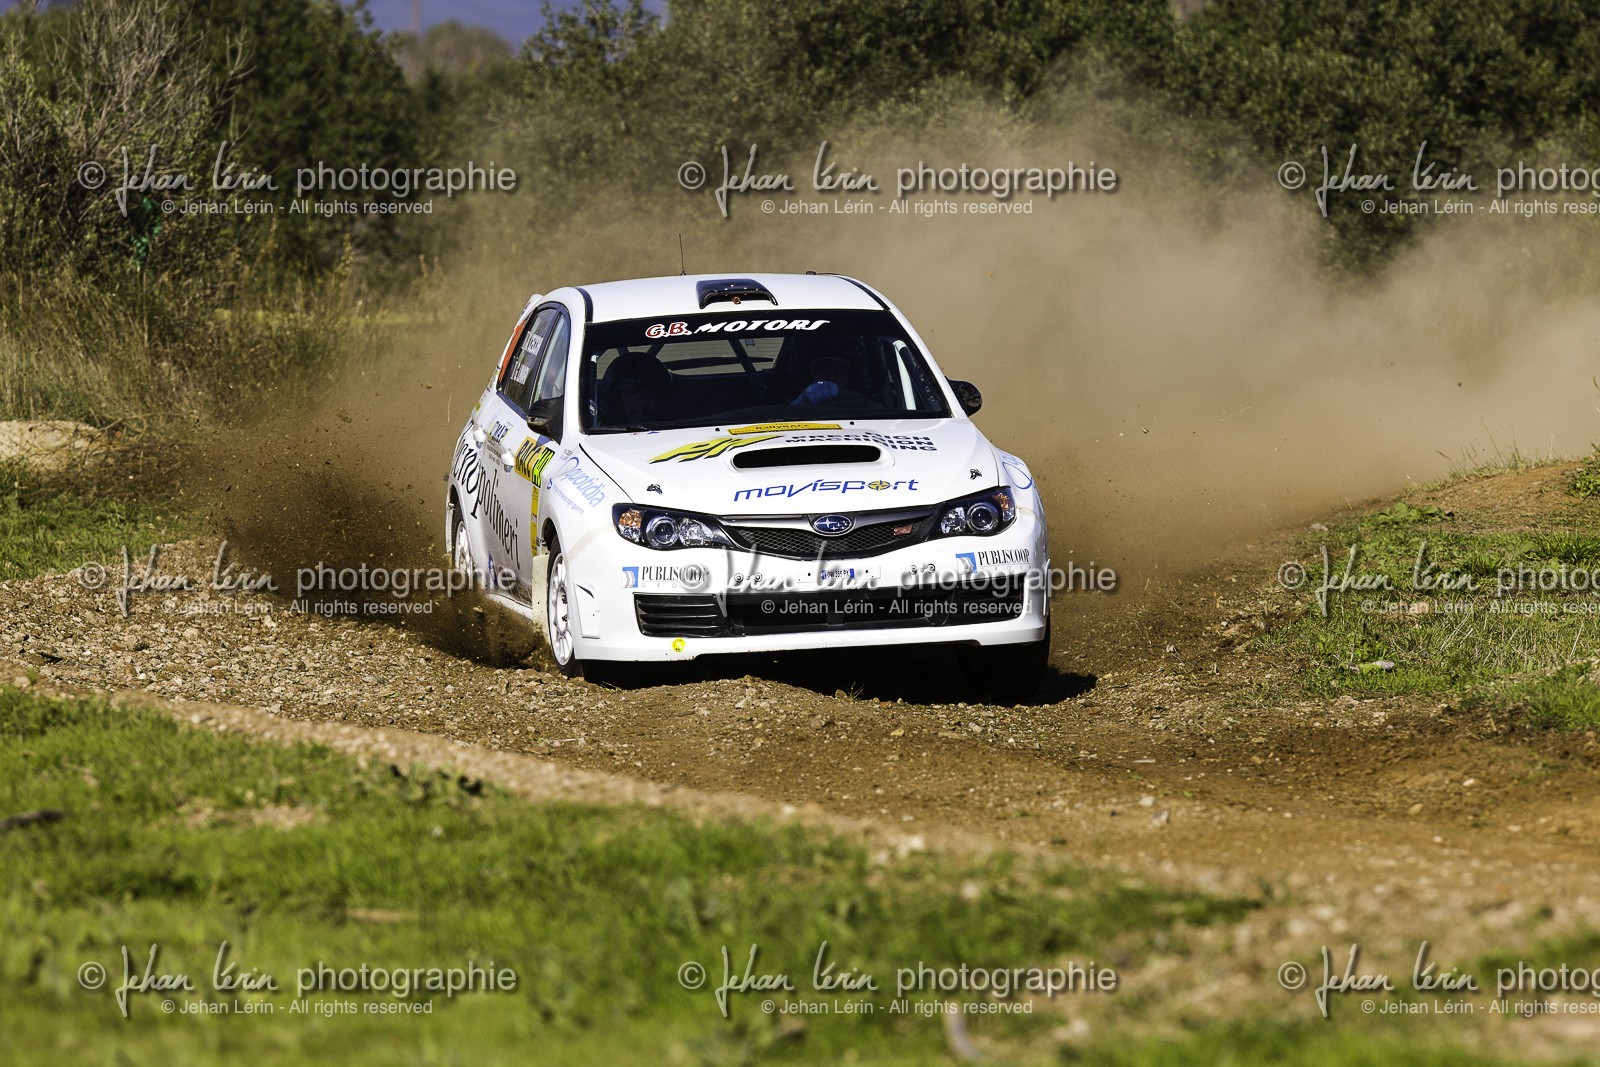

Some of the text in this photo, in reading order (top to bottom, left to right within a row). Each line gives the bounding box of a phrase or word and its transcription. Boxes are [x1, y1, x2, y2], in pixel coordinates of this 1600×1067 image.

[694, 319, 830, 334] MOTORS
[786, 437, 938, 451] MACHINING
[978, 549, 1030, 565] PUBLISCOOP
